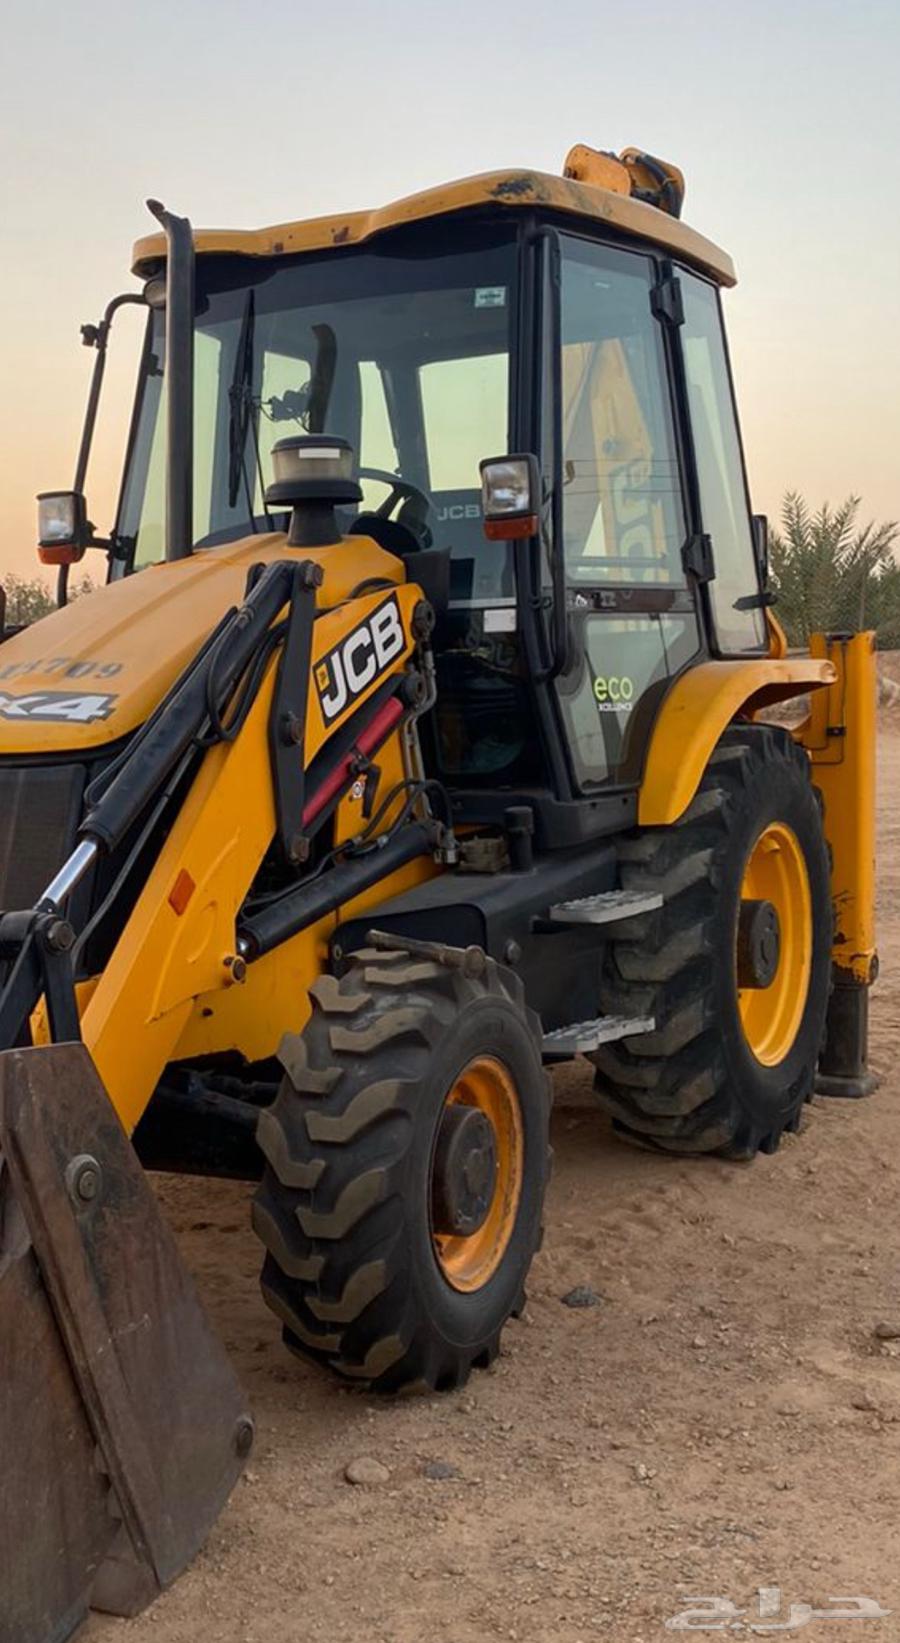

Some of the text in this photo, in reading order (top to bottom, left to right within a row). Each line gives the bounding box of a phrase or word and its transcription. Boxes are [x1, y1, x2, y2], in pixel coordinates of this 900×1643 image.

[437, 504, 480, 520] JCB
[322, 601, 404, 718] JCB
[594, 676, 633, 701] eco
